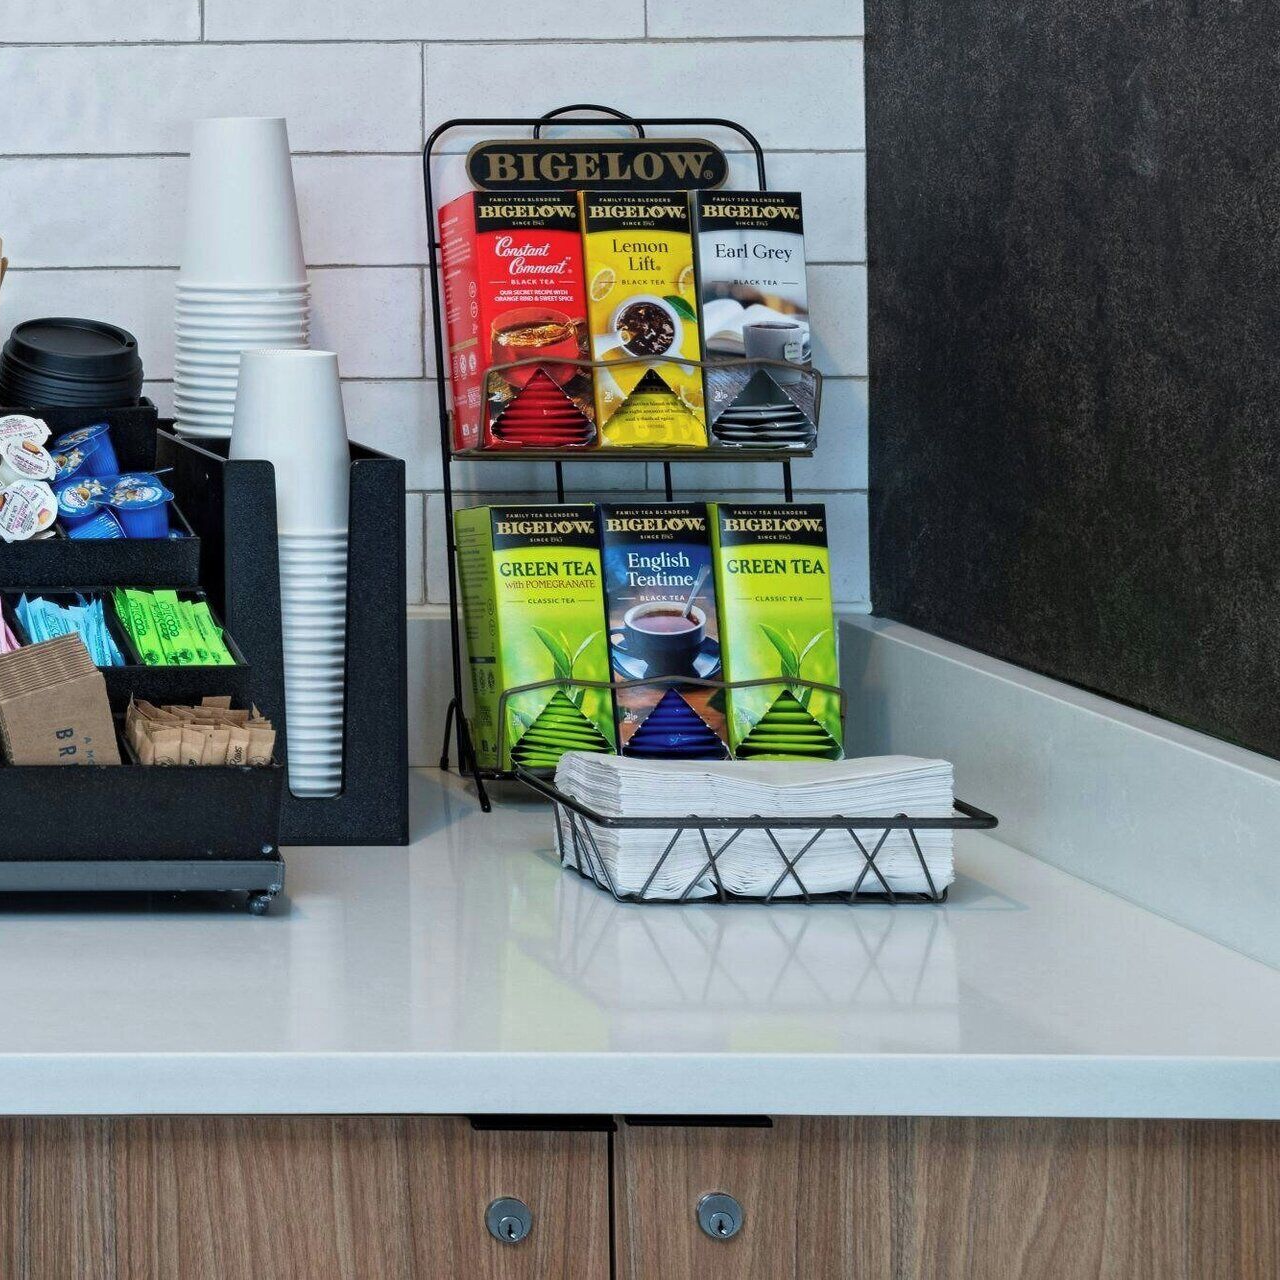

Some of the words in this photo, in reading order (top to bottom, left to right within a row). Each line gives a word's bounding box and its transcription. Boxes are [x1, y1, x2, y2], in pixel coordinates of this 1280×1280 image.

[612, 239, 669, 253] Lemon
[715, 243, 748, 259] Earl
[752, 243, 793, 263] Grey
[500, 561, 559, 577] GREEN
[562, 561, 597, 576] TEA
[627, 551, 691, 572] English
[726, 559, 787, 574] GREEN
[790, 559, 826, 574] TEA
[504, 581, 524, 589] with
[525, 579, 596, 589] POMEGRANATE
[625, 571, 694, 587] Teatime
